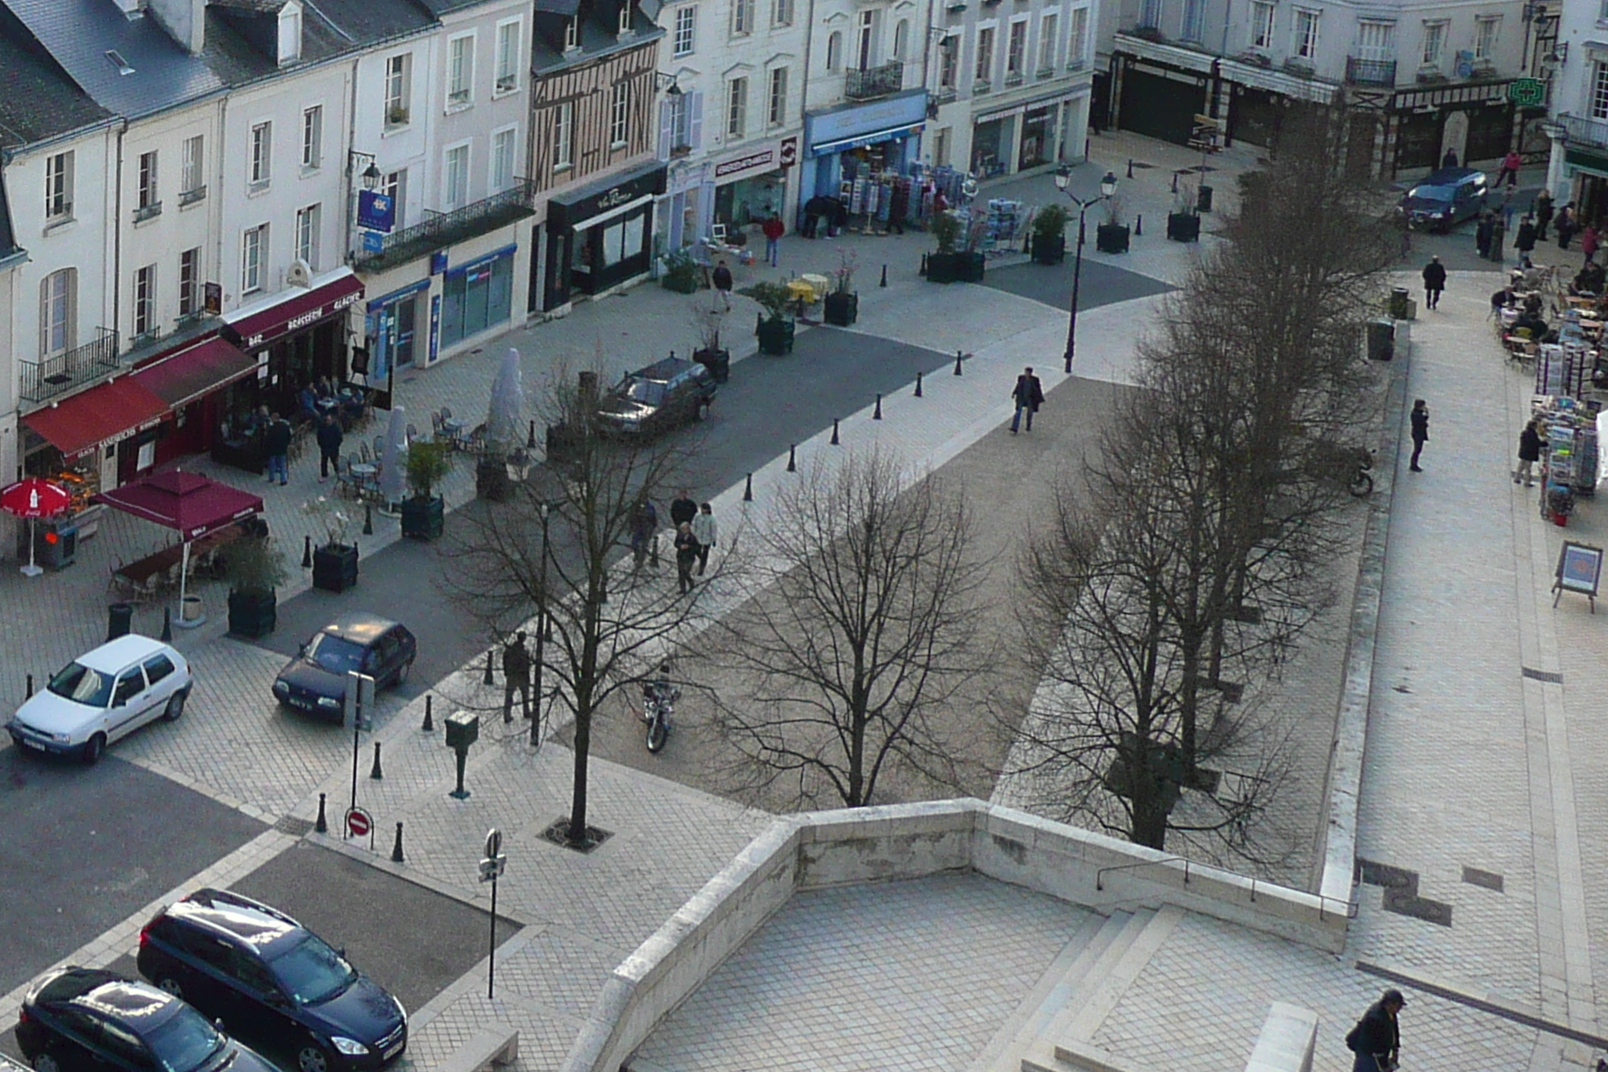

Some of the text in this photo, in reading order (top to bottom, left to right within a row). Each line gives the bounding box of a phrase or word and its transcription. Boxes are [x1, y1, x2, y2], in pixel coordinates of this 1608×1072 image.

[249, 334, 263, 348] BAR
[288, 306, 323, 330] BRASSERIE
[334, 292, 361, 310] GLACIER
